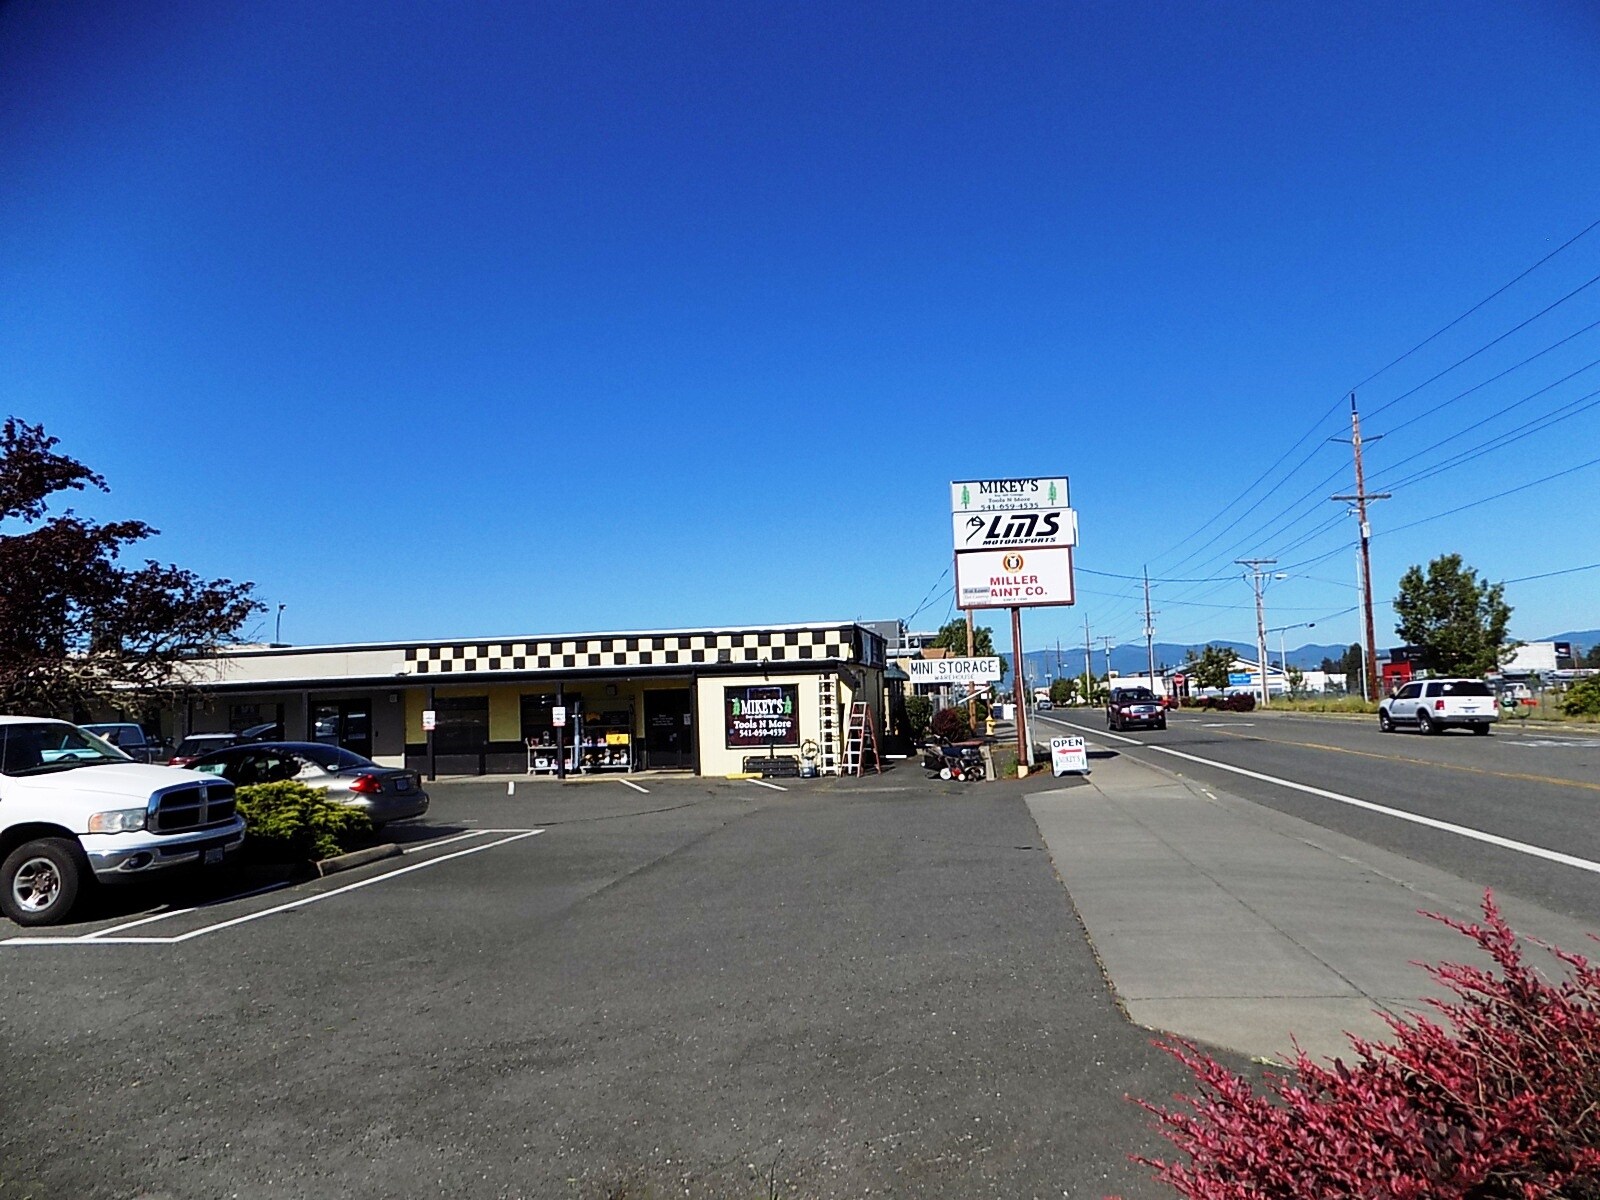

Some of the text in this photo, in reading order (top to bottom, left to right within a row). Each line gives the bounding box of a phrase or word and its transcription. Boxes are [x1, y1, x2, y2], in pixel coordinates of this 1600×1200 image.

[979, 479, 1039, 494] MIKEY'S
[982, 537, 1057, 546] MOTORSPORTS
[989, 575, 1039, 586] MILLER
[990, 587, 1021, 597] AINT
[1025, 586, 1048, 596] CO.
[910, 660, 996, 675] MINI STORAGE
[741, 699, 784, 715] MIKEY'S
[733, 719, 792, 729] Tools N More
[739, 728, 787, 738] 541-659-4535
[1052, 738, 1083, 748] OPEN
